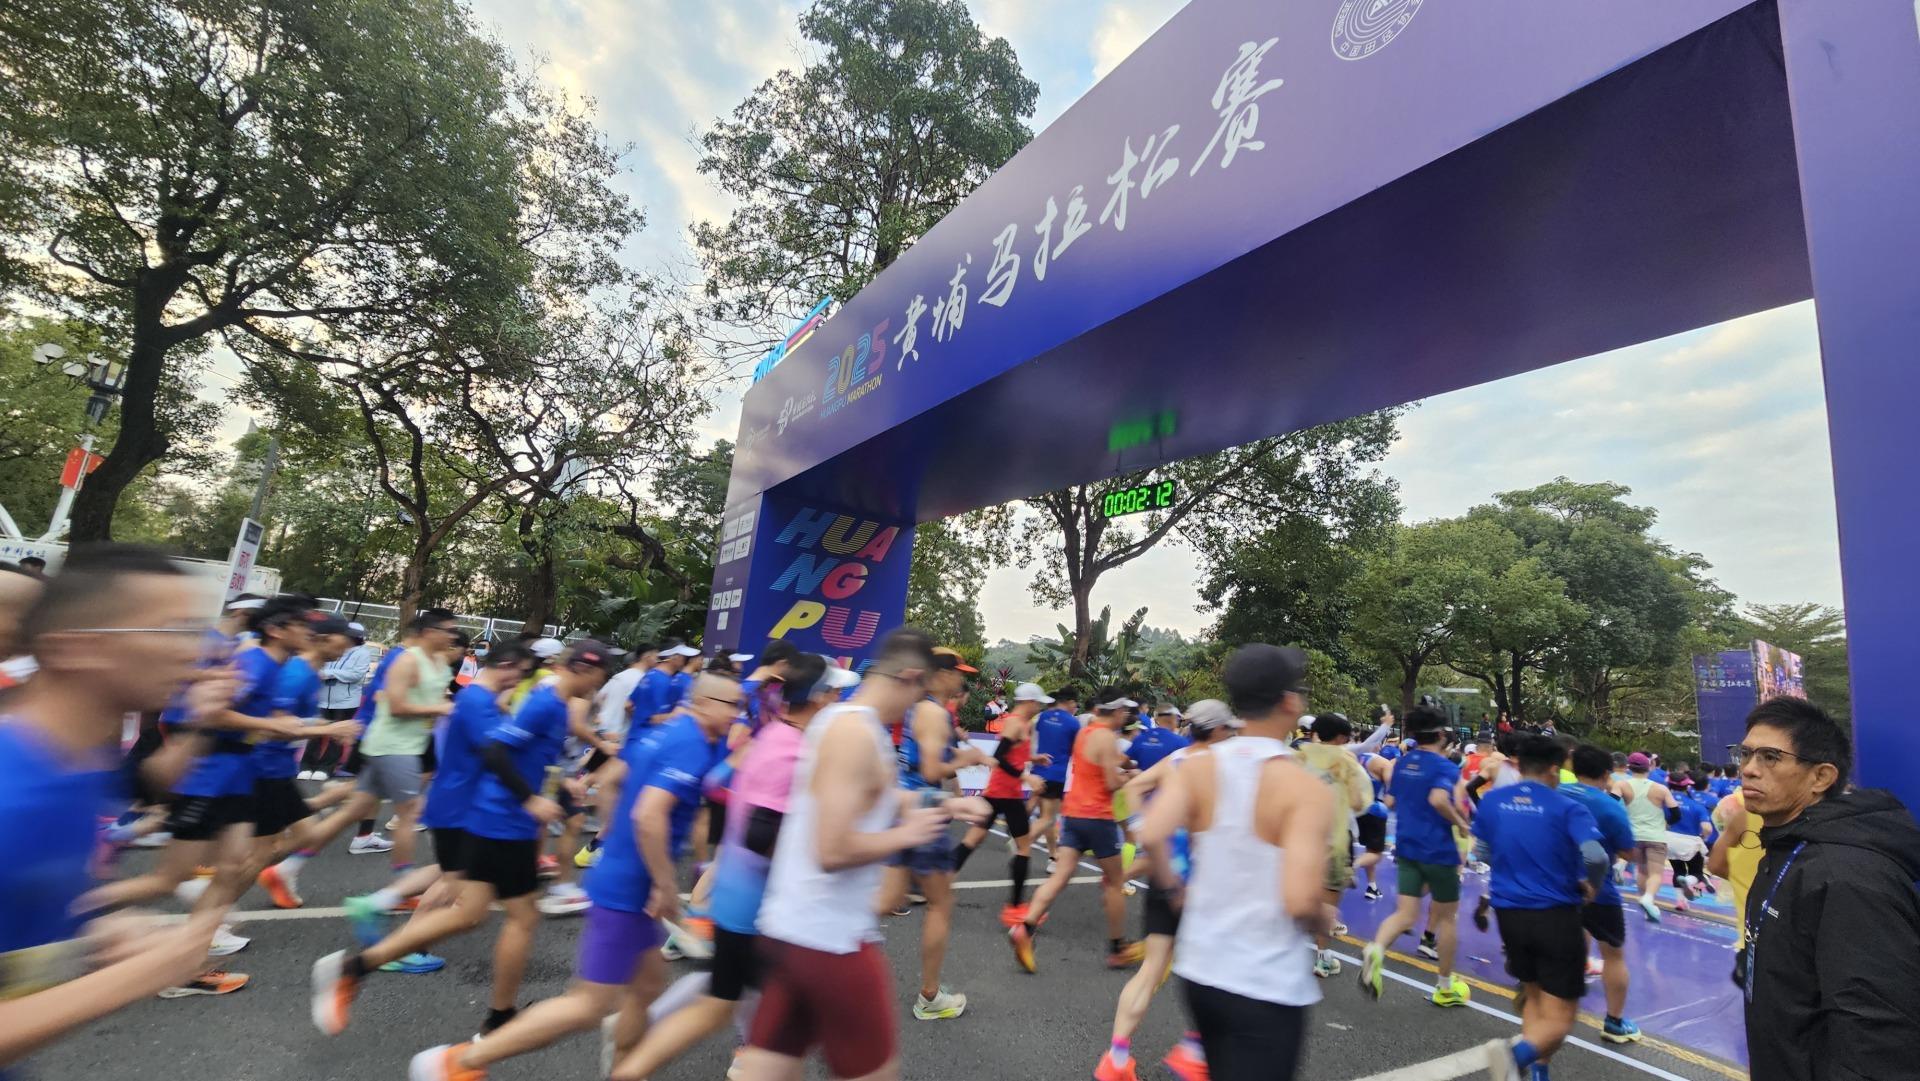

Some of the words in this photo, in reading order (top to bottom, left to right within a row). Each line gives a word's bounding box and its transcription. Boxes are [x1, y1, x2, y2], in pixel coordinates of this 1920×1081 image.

[893, 37, 1284, 371] 黄埔马拉松赛
[822, 318, 890, 405] 2025
[846, 373, 883, 403] MARATHON
[774, 507, 900, 562] HUA
[769, 552, 869, 599] NG
[767, 599, 882, 649] PU
